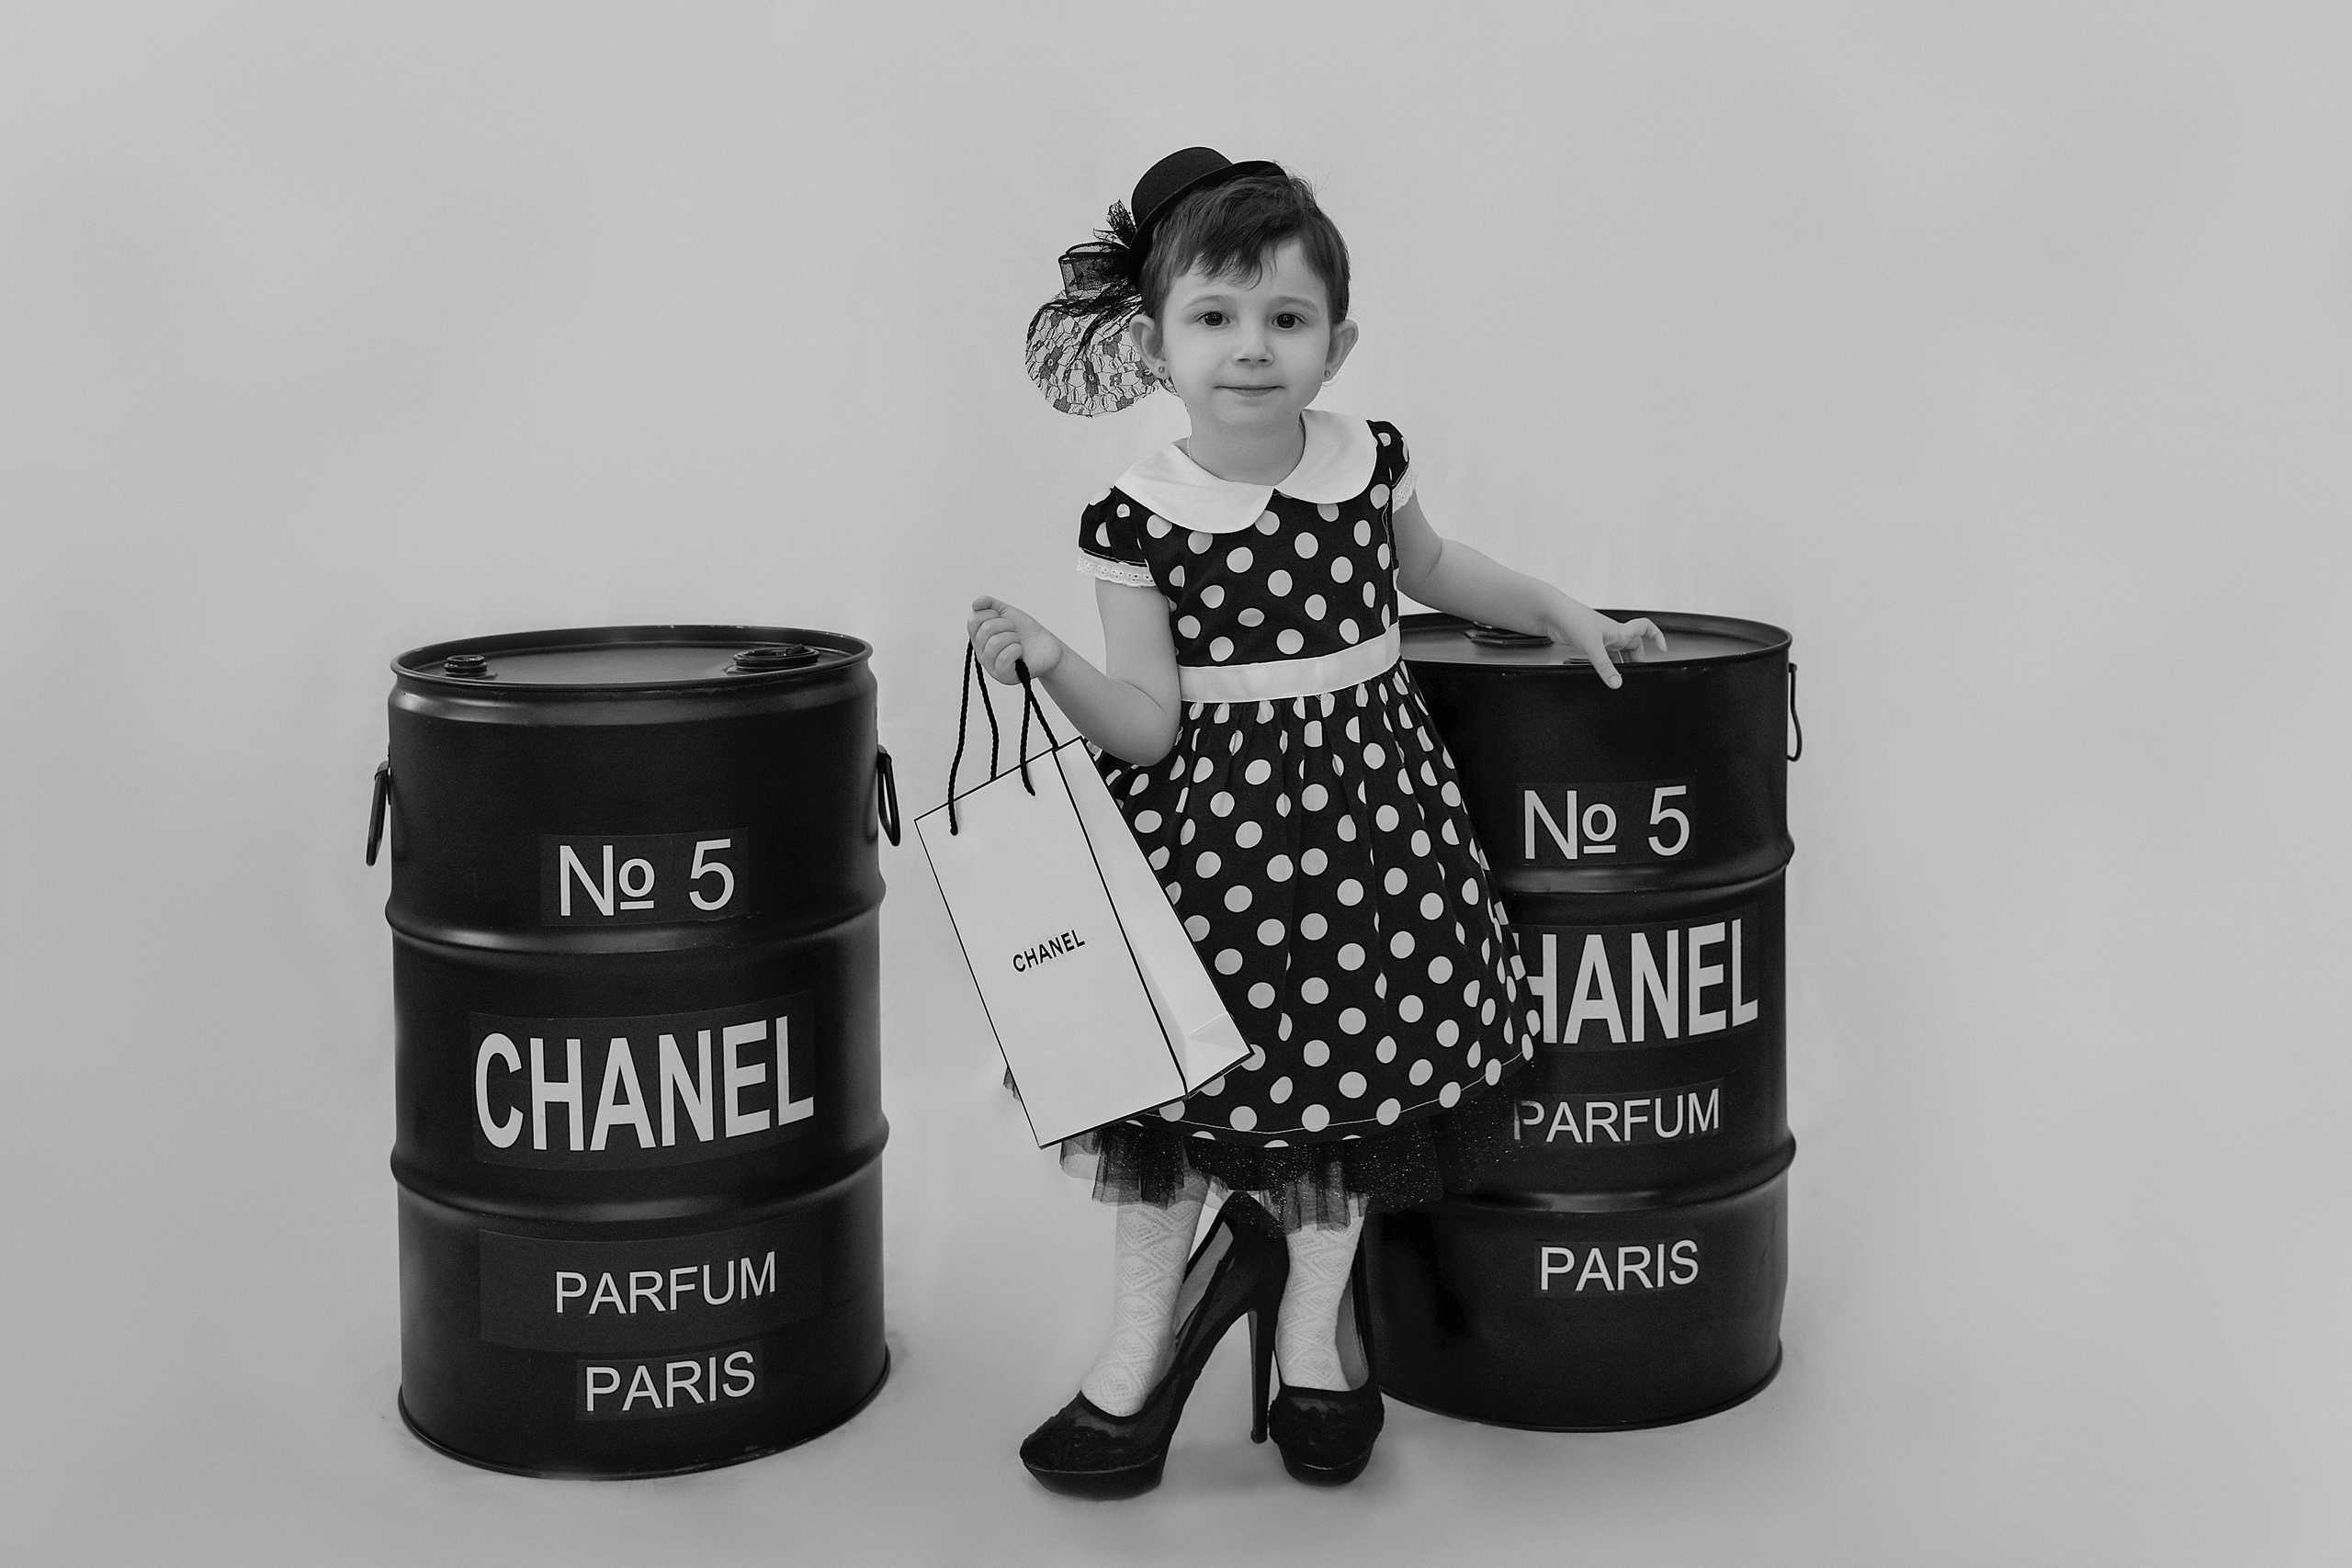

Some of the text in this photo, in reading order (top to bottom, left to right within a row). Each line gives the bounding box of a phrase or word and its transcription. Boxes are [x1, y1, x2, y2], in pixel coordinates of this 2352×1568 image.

[1647, 784, 1690, 856] 5
[688, 838, 735, 911] 5
[1012, 928, 1087, 974] CHANEL
[1512, 918, 1758, 1044] HANEL
[475, 1015, 815, 1151] CHANEL
[1513, 1088, 1720, 1144] PARFUM
[556, 1250, 776, 1314] PARFUM
[1541, 1239, 1700, 1292] PARIS
[585, 1350, 756, 1412] PARIS
